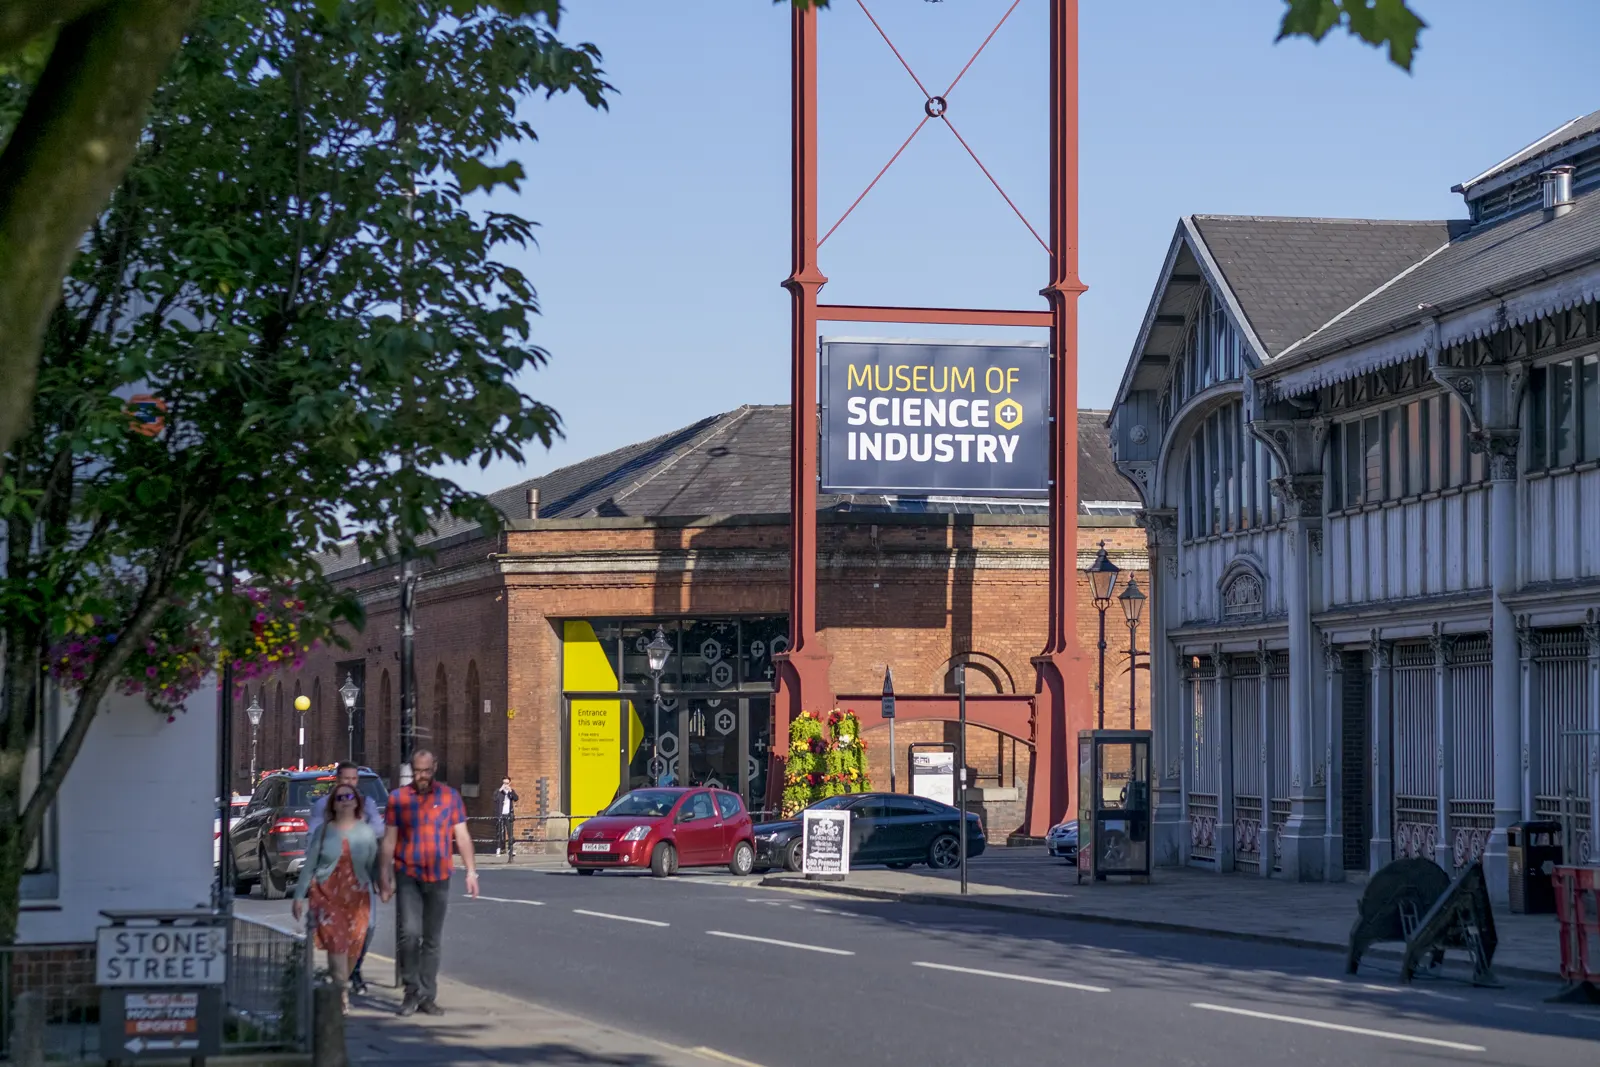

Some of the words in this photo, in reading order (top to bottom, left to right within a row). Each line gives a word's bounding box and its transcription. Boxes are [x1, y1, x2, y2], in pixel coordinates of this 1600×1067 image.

[847, 364, 976, 393] MUSEUM
[985, 367, 1020, 394] OF
[847, 396, 990, 428] SCIENCE
[847, 432, 1020, 463] INDUSTRY
[115, 932, 208, 954] STONE
[107, 957, 214, 979] STREET
